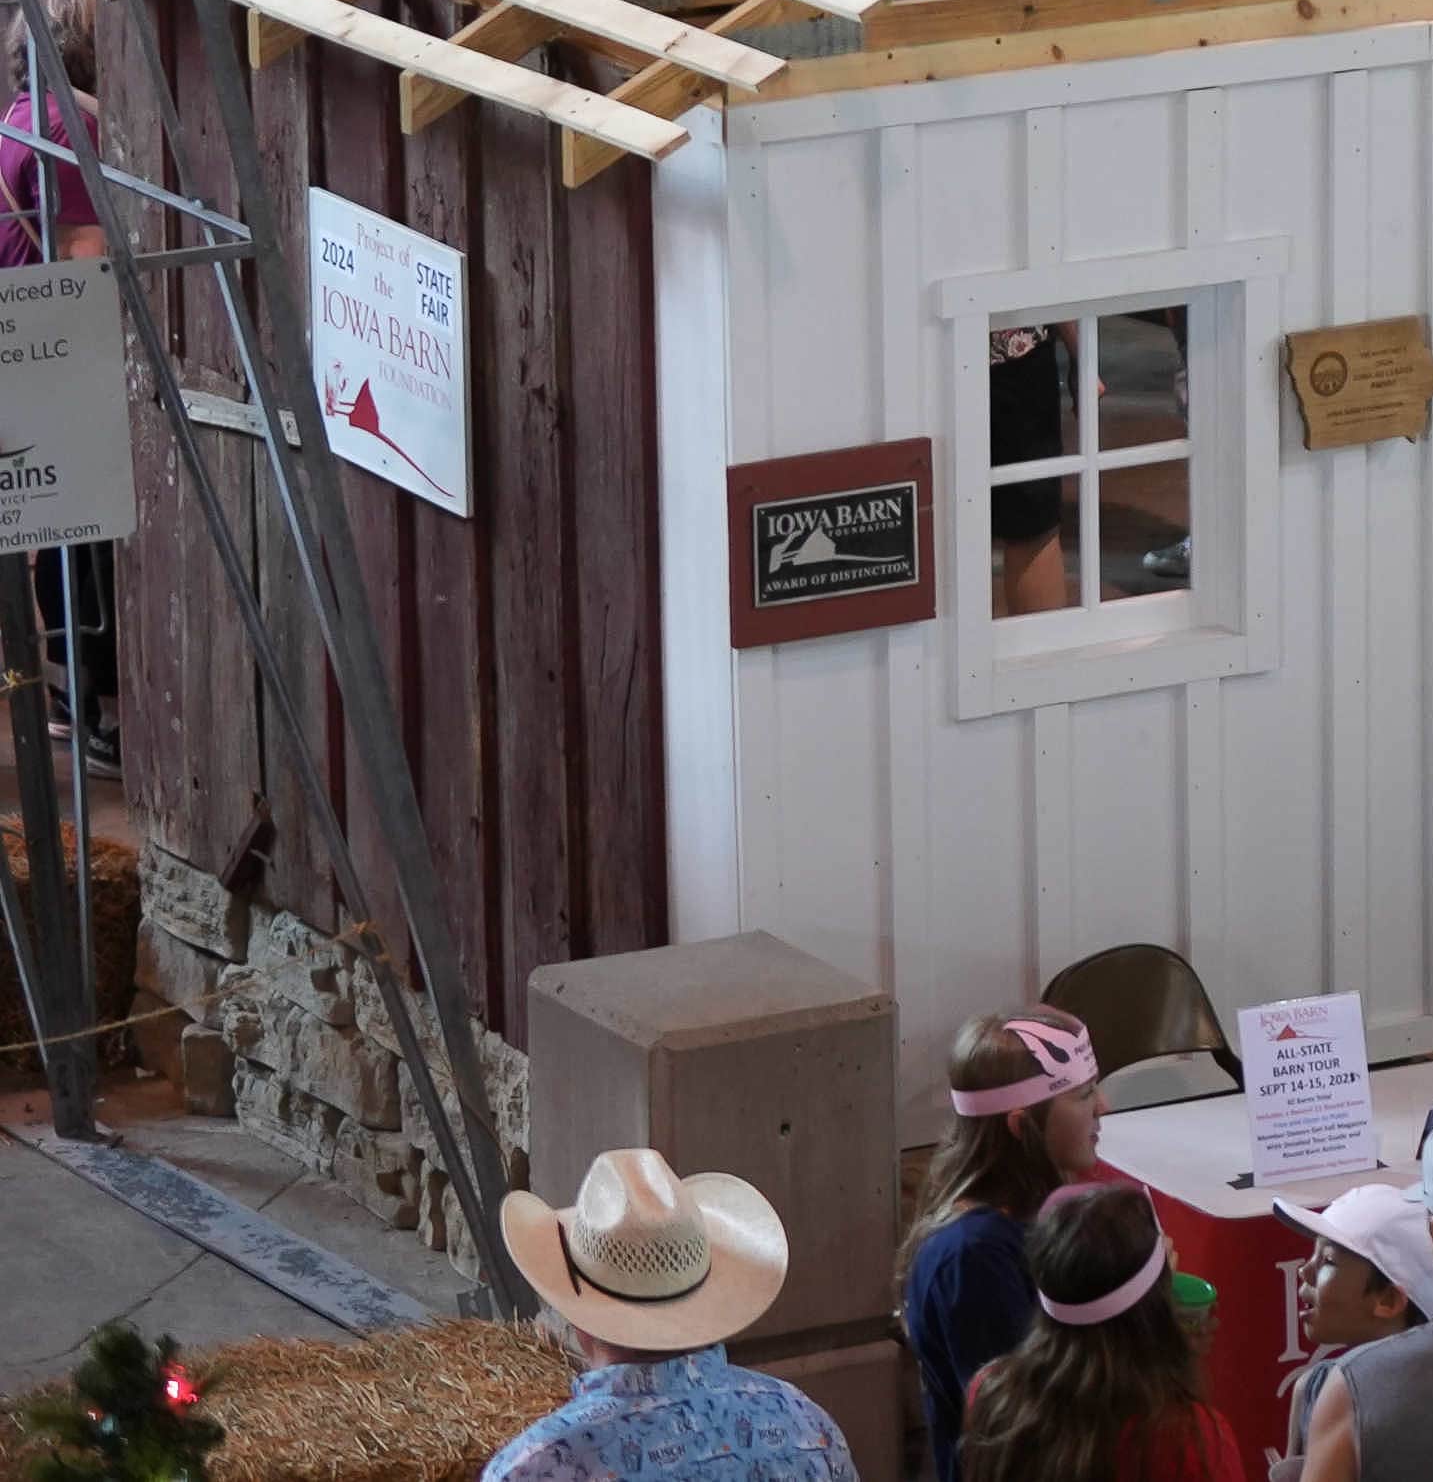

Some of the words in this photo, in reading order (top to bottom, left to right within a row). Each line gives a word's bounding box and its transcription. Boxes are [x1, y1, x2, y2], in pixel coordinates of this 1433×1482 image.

[322, 237, 354, 274] 2024
[357, 223, 395, 262] Project
[400, 245, 411, 269] of
[60, 277, 86, 299] By
[374, 272, 394, 300] the
[416, 262, 452, 300] STATE
[421, 294, 449, 326] FAIR
[322, 285, 383, 349] IOWA
[389, 316, 450, 380] BARN
[31, 340, 69, 360] LLC
[379, 361, 452, 411] FOUNDATION
[768, 509, 833, 537] IOWA
[836, 497, 902, 527] BARN
[828, 520, 901, 537] FOUNDATION
[765, 578, 807, 592] AWARD
[811, 574, 826, 585] OF
[830, 561, 910, 583] DISTINCTION
[1277, 1042, 1333, 1060] ALL-STATE
[1273, 1064, 1305, 1078] BARN
[1308, 1058, 1340, 1072] TOUR
[1260, 1085, 1286, 1097] SEPT
[1292, 1077, 1325, 1092] 14-15,
